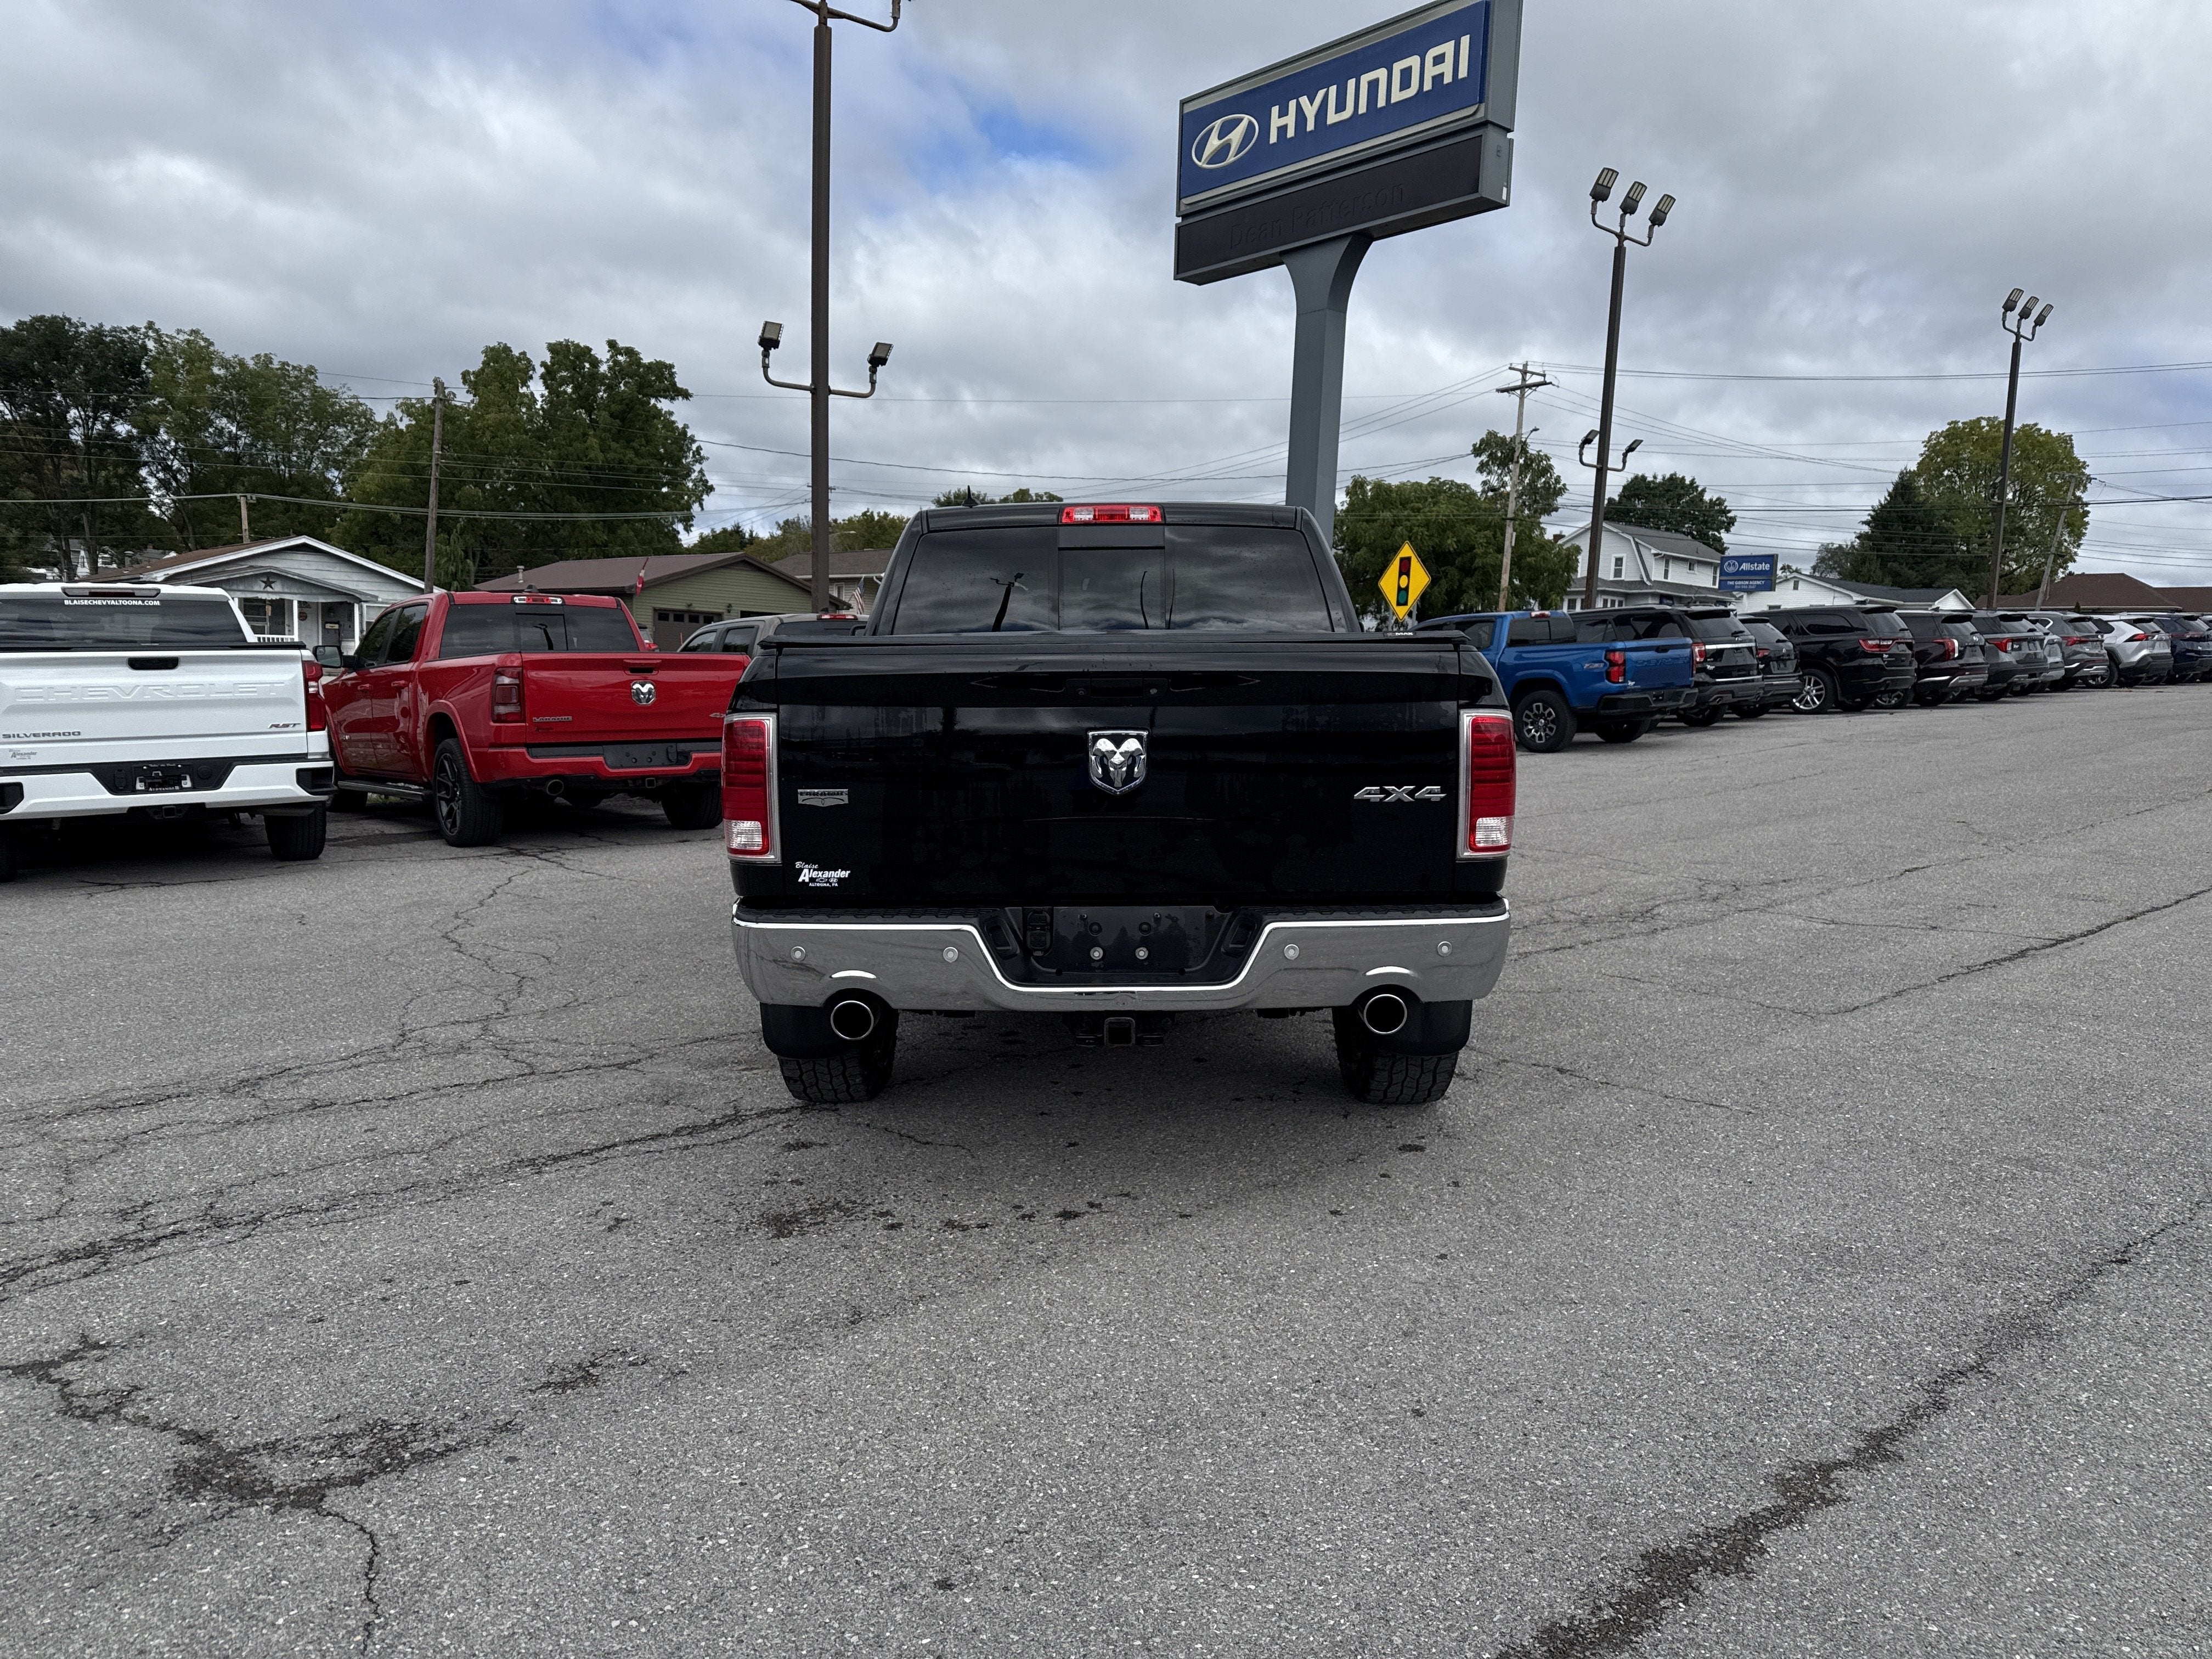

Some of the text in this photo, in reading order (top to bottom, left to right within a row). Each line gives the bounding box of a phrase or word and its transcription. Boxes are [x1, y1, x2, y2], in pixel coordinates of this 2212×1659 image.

[1269, 34, 1470, 144] HYUNDAI
[1230, 183, 1404, 250] Dean Patterson
[1739, 562, 1770, 571] Allstate
[14, 682, 286, 702] CHEVROLET
[1353, 786, 1447, 802] 4X4
[798, 868, 851, 882] Alexander
